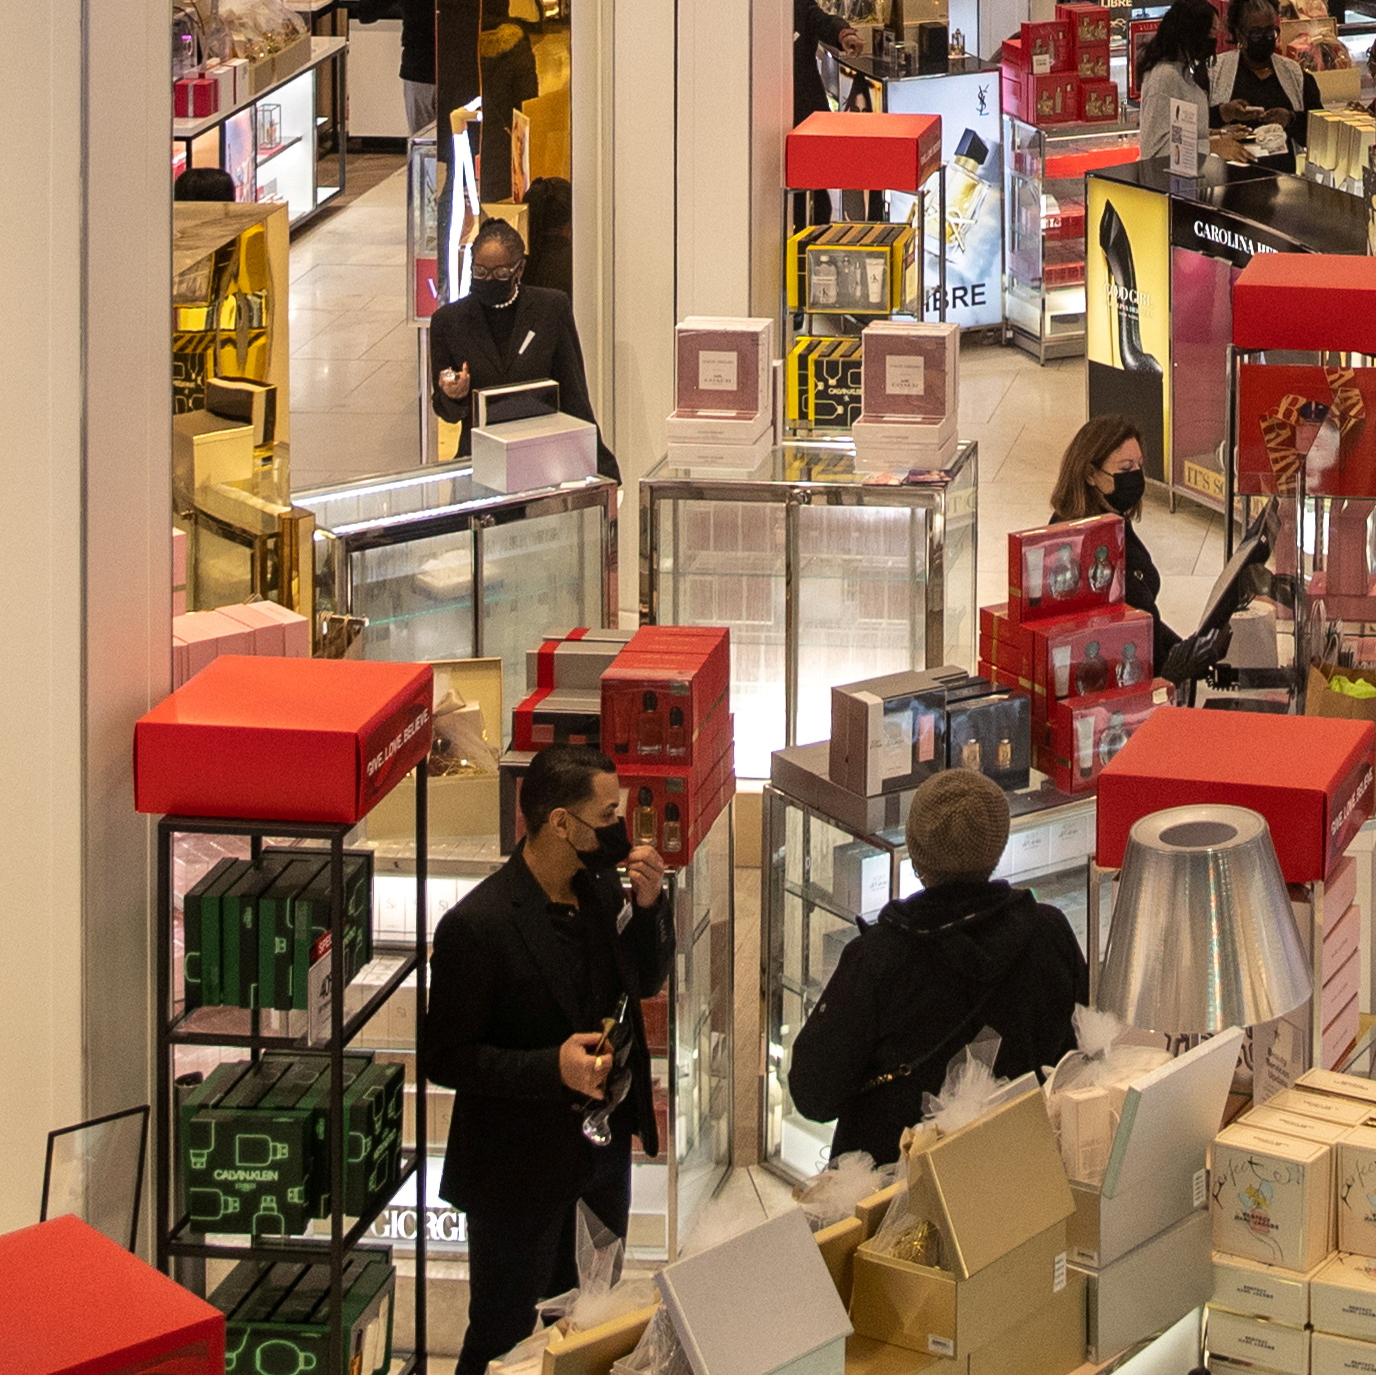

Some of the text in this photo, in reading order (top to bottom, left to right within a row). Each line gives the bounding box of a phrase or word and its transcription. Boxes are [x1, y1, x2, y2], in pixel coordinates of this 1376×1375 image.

[1193, 220, 1255, 256] CAROLINA
[925, 283, 987, 313] IBRE
[367, 709, 431, 777] GIVE. LOVE. BELIEVE.
